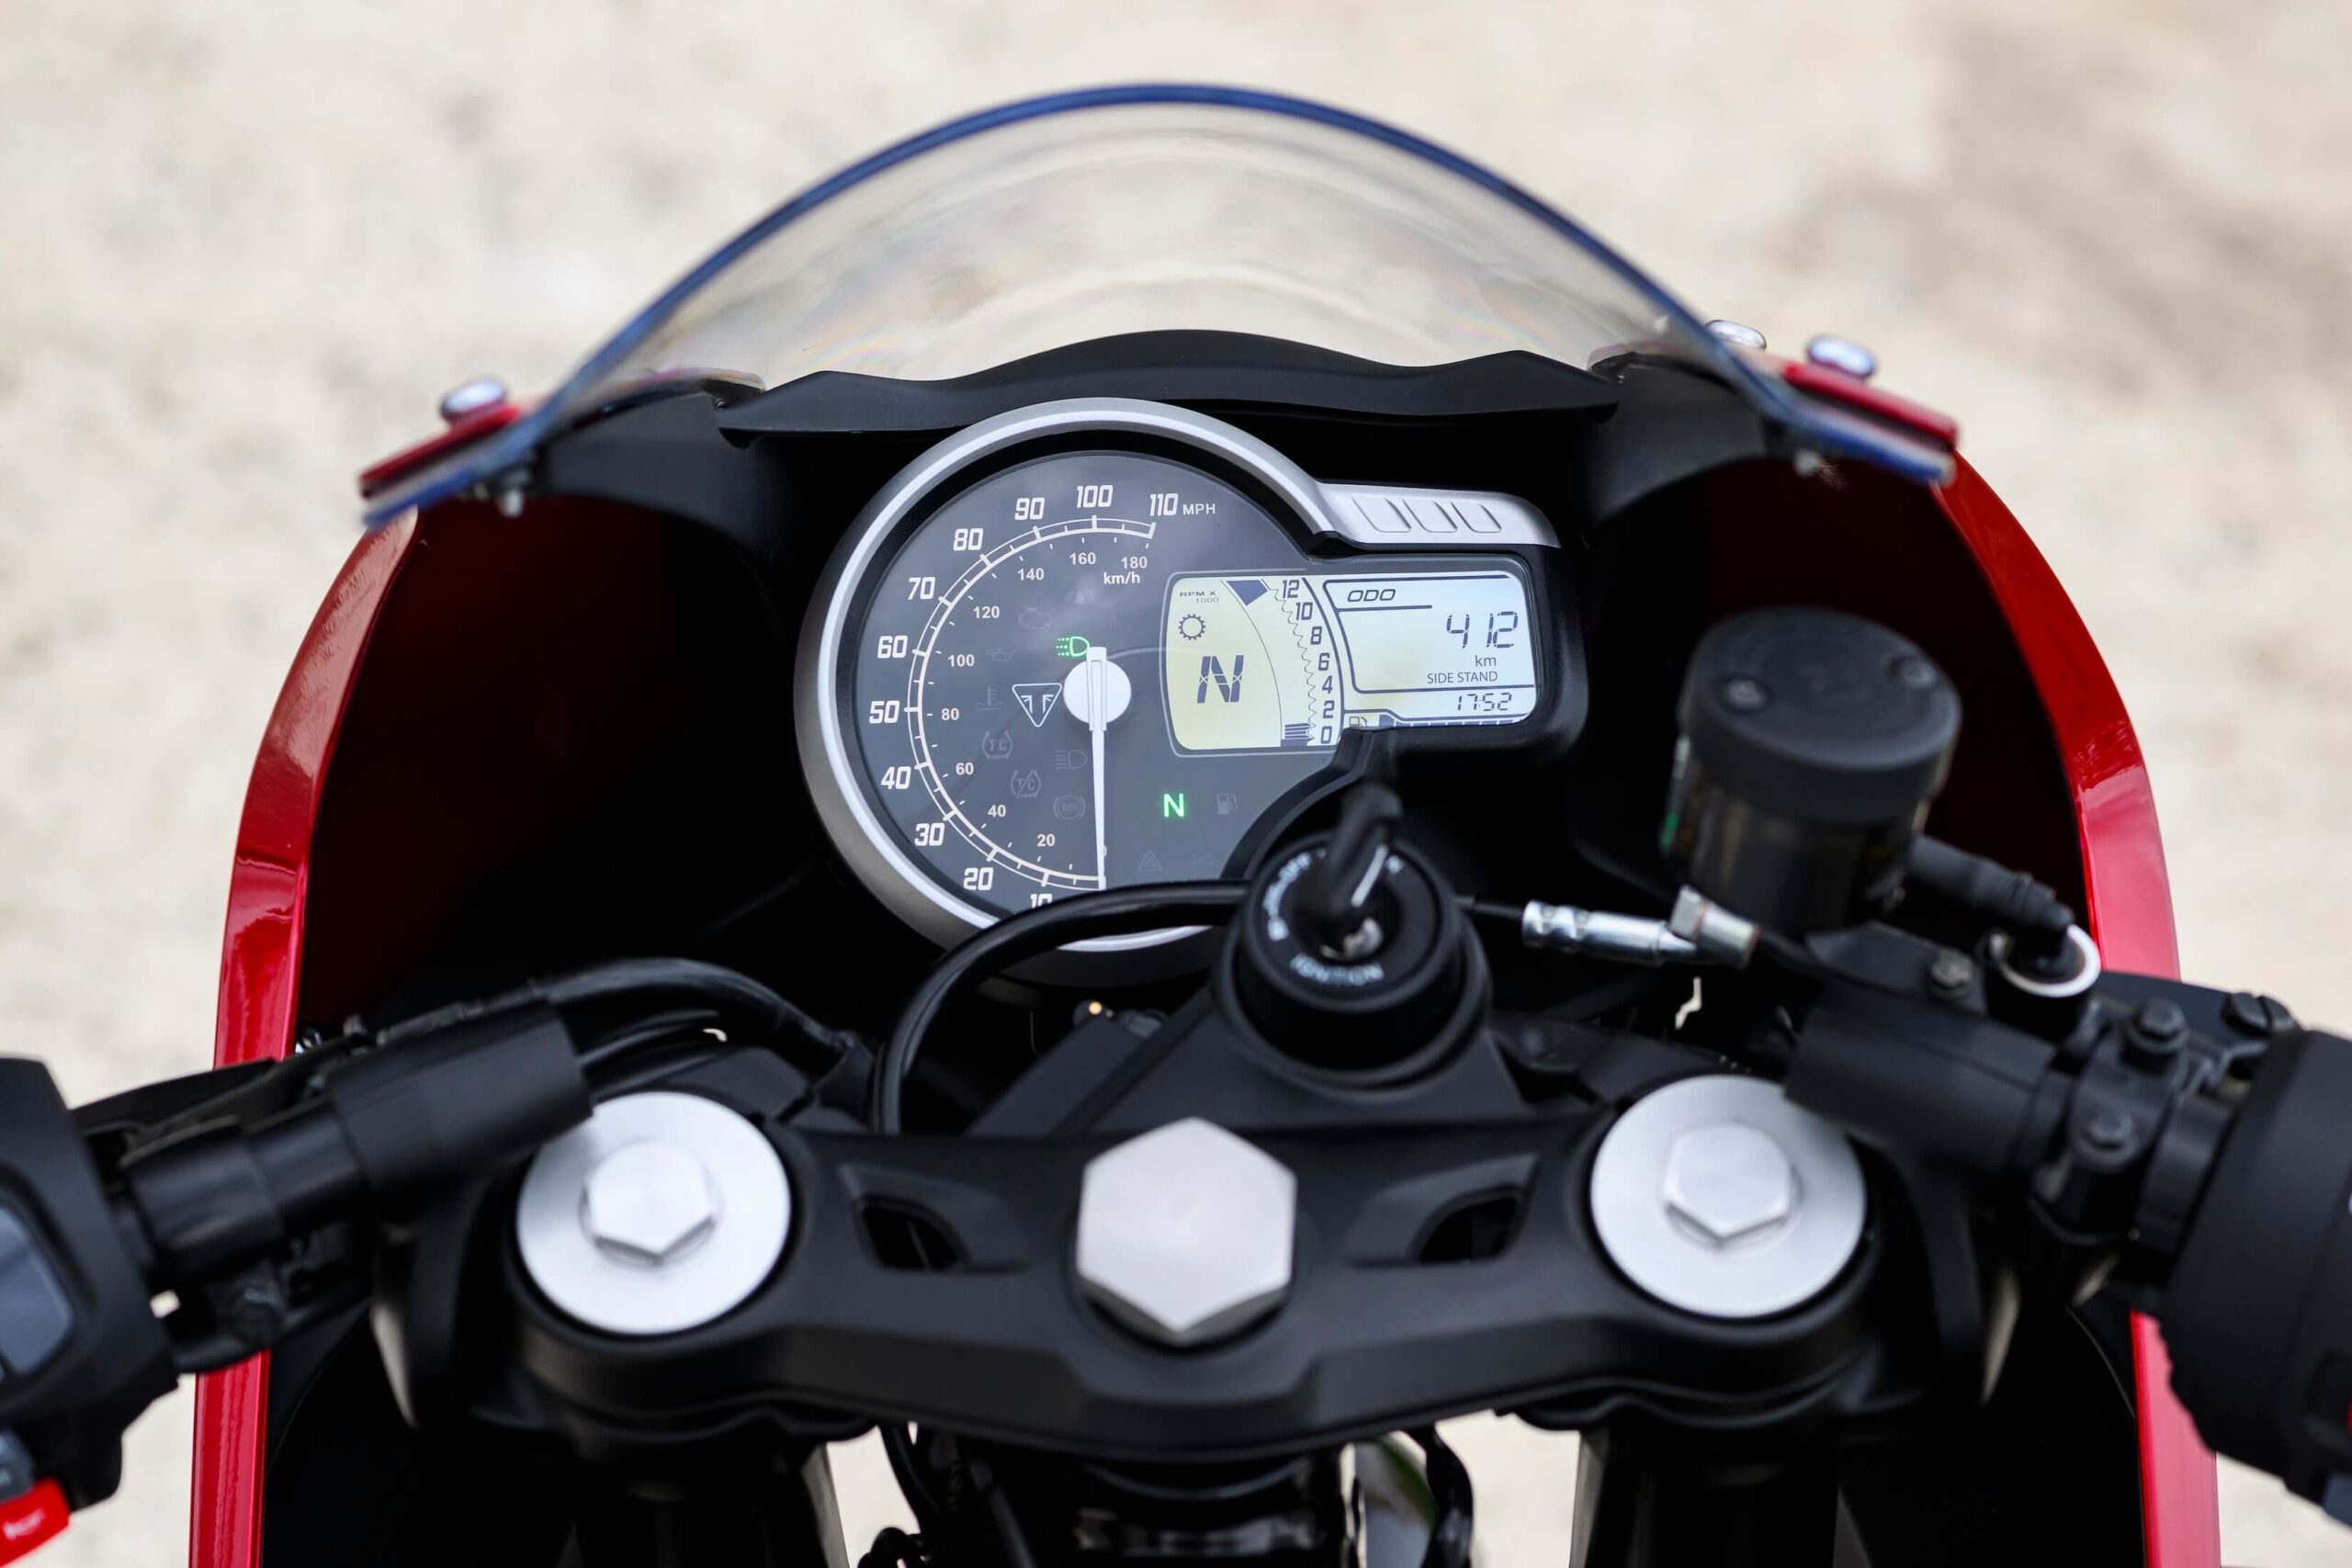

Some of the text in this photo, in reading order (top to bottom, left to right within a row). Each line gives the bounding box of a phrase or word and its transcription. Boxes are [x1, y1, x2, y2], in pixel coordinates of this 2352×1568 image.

[1076, 484, 1114, 508] 100
[1149, 493, 1216, 516] 110 MPH
[1014, 497, 1046, 521] 90
[953, 527, 984, 551] 80
[1069, 551, 1096, 565] 160
[1121, 556, 1148, 570] 180
[1017, 568, 1045, 581] 140
[1103, 571, 1140, 584] km/h
[908, 576, 935, 600] 70
[1282, 580, 1300, 599] 12
[1347, 589, 1396, 603] ODO
[973, 605, 1001, 619] 120
[1295, 602, 1313, 621] 10
[1310, 626, 1323, 645] 8
[1446, 611, 1519, 649] 412
[876, 635, 908, 659] 60
[947, 654, 975, 667] 100
[1318, 652, 1330, 671] 6
[1476, 655, 1497, 668] km
[1196, 655, 1244, 704] N
[1321, 675, 1334, 694] 4
[1427, 671, 1498, 684] SIDE STAND
[868, 700, 900, 724] 50
[941, 708, 959, 721] 80
[1323, 700, 1335, 718] 2
[1320, 726, 1333, 744] 0
[880, 766, 911, 790] 40
[956, 762, 974, 776] 60
[988, 805, 1006, 818] 40
[1163, 793, 1185, 818] N
[914, 823, 944, 846] 30
[1036, 834, 1056, 847] 20
[963, 867, 994, 891] 20
